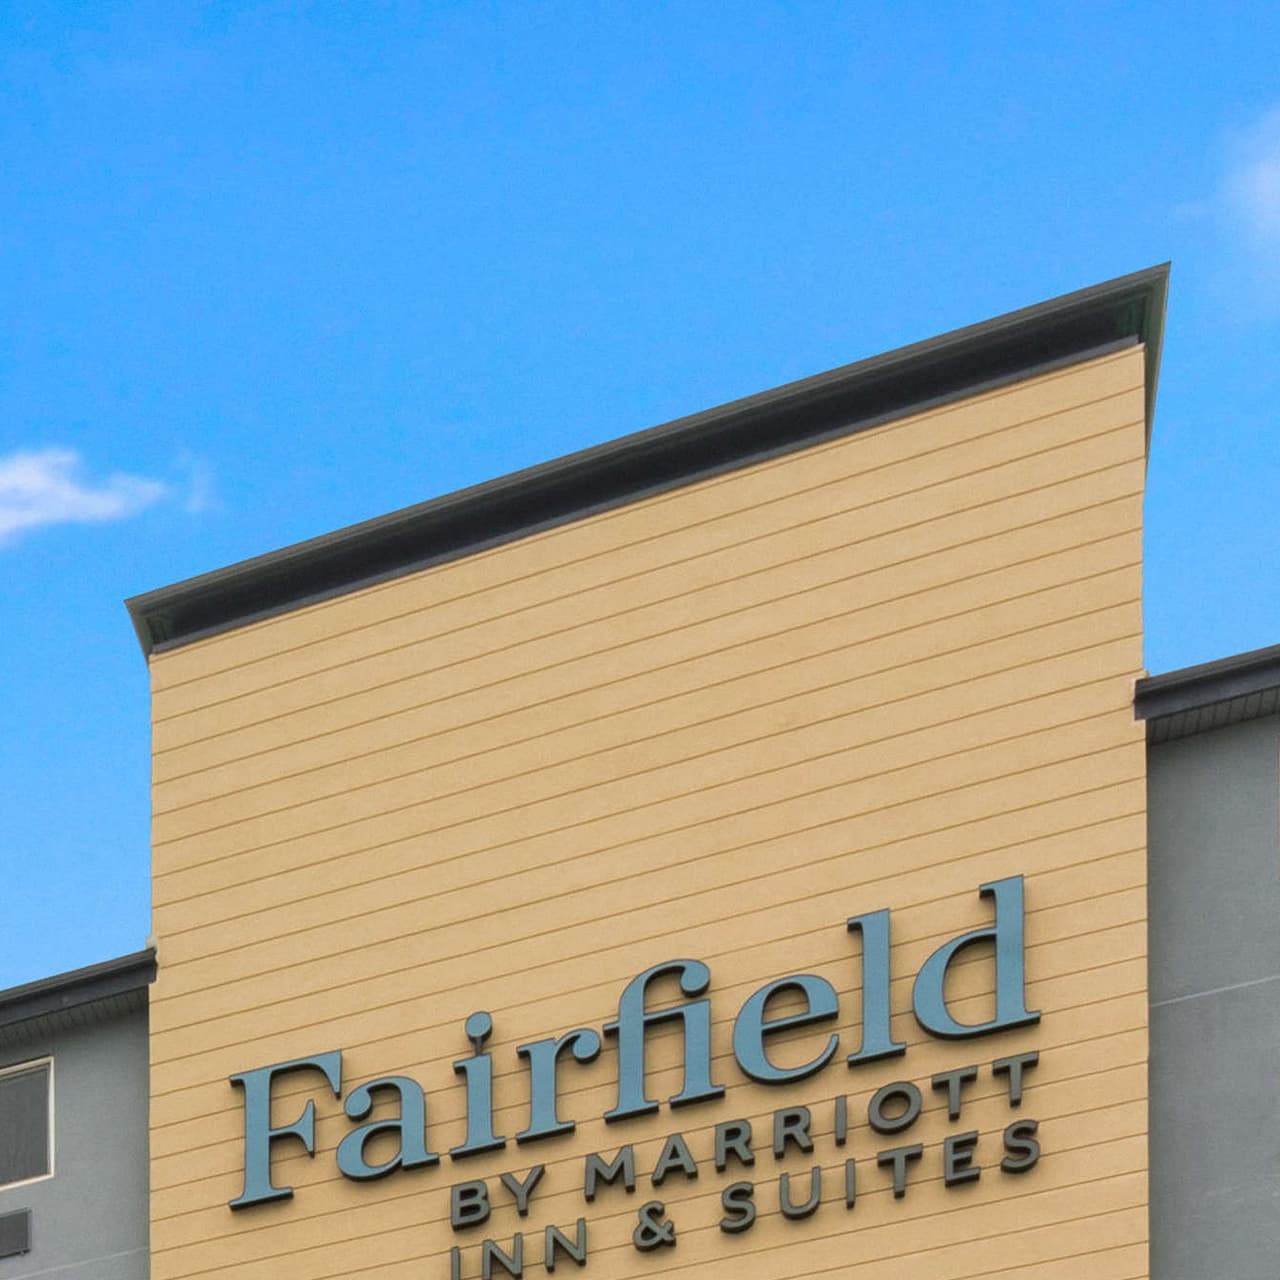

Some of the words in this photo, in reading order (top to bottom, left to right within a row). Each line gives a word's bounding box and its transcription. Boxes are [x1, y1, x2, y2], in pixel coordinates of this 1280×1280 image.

[229, 874, 1042, 1211] Fairfield
[450, 1165, 545, 1233] BY
[584, 1051, 1040, 1202] MARRIOTT
[633, 1200, 677, 1254] &
[720, 1119, 1040, 1237] SUITES
